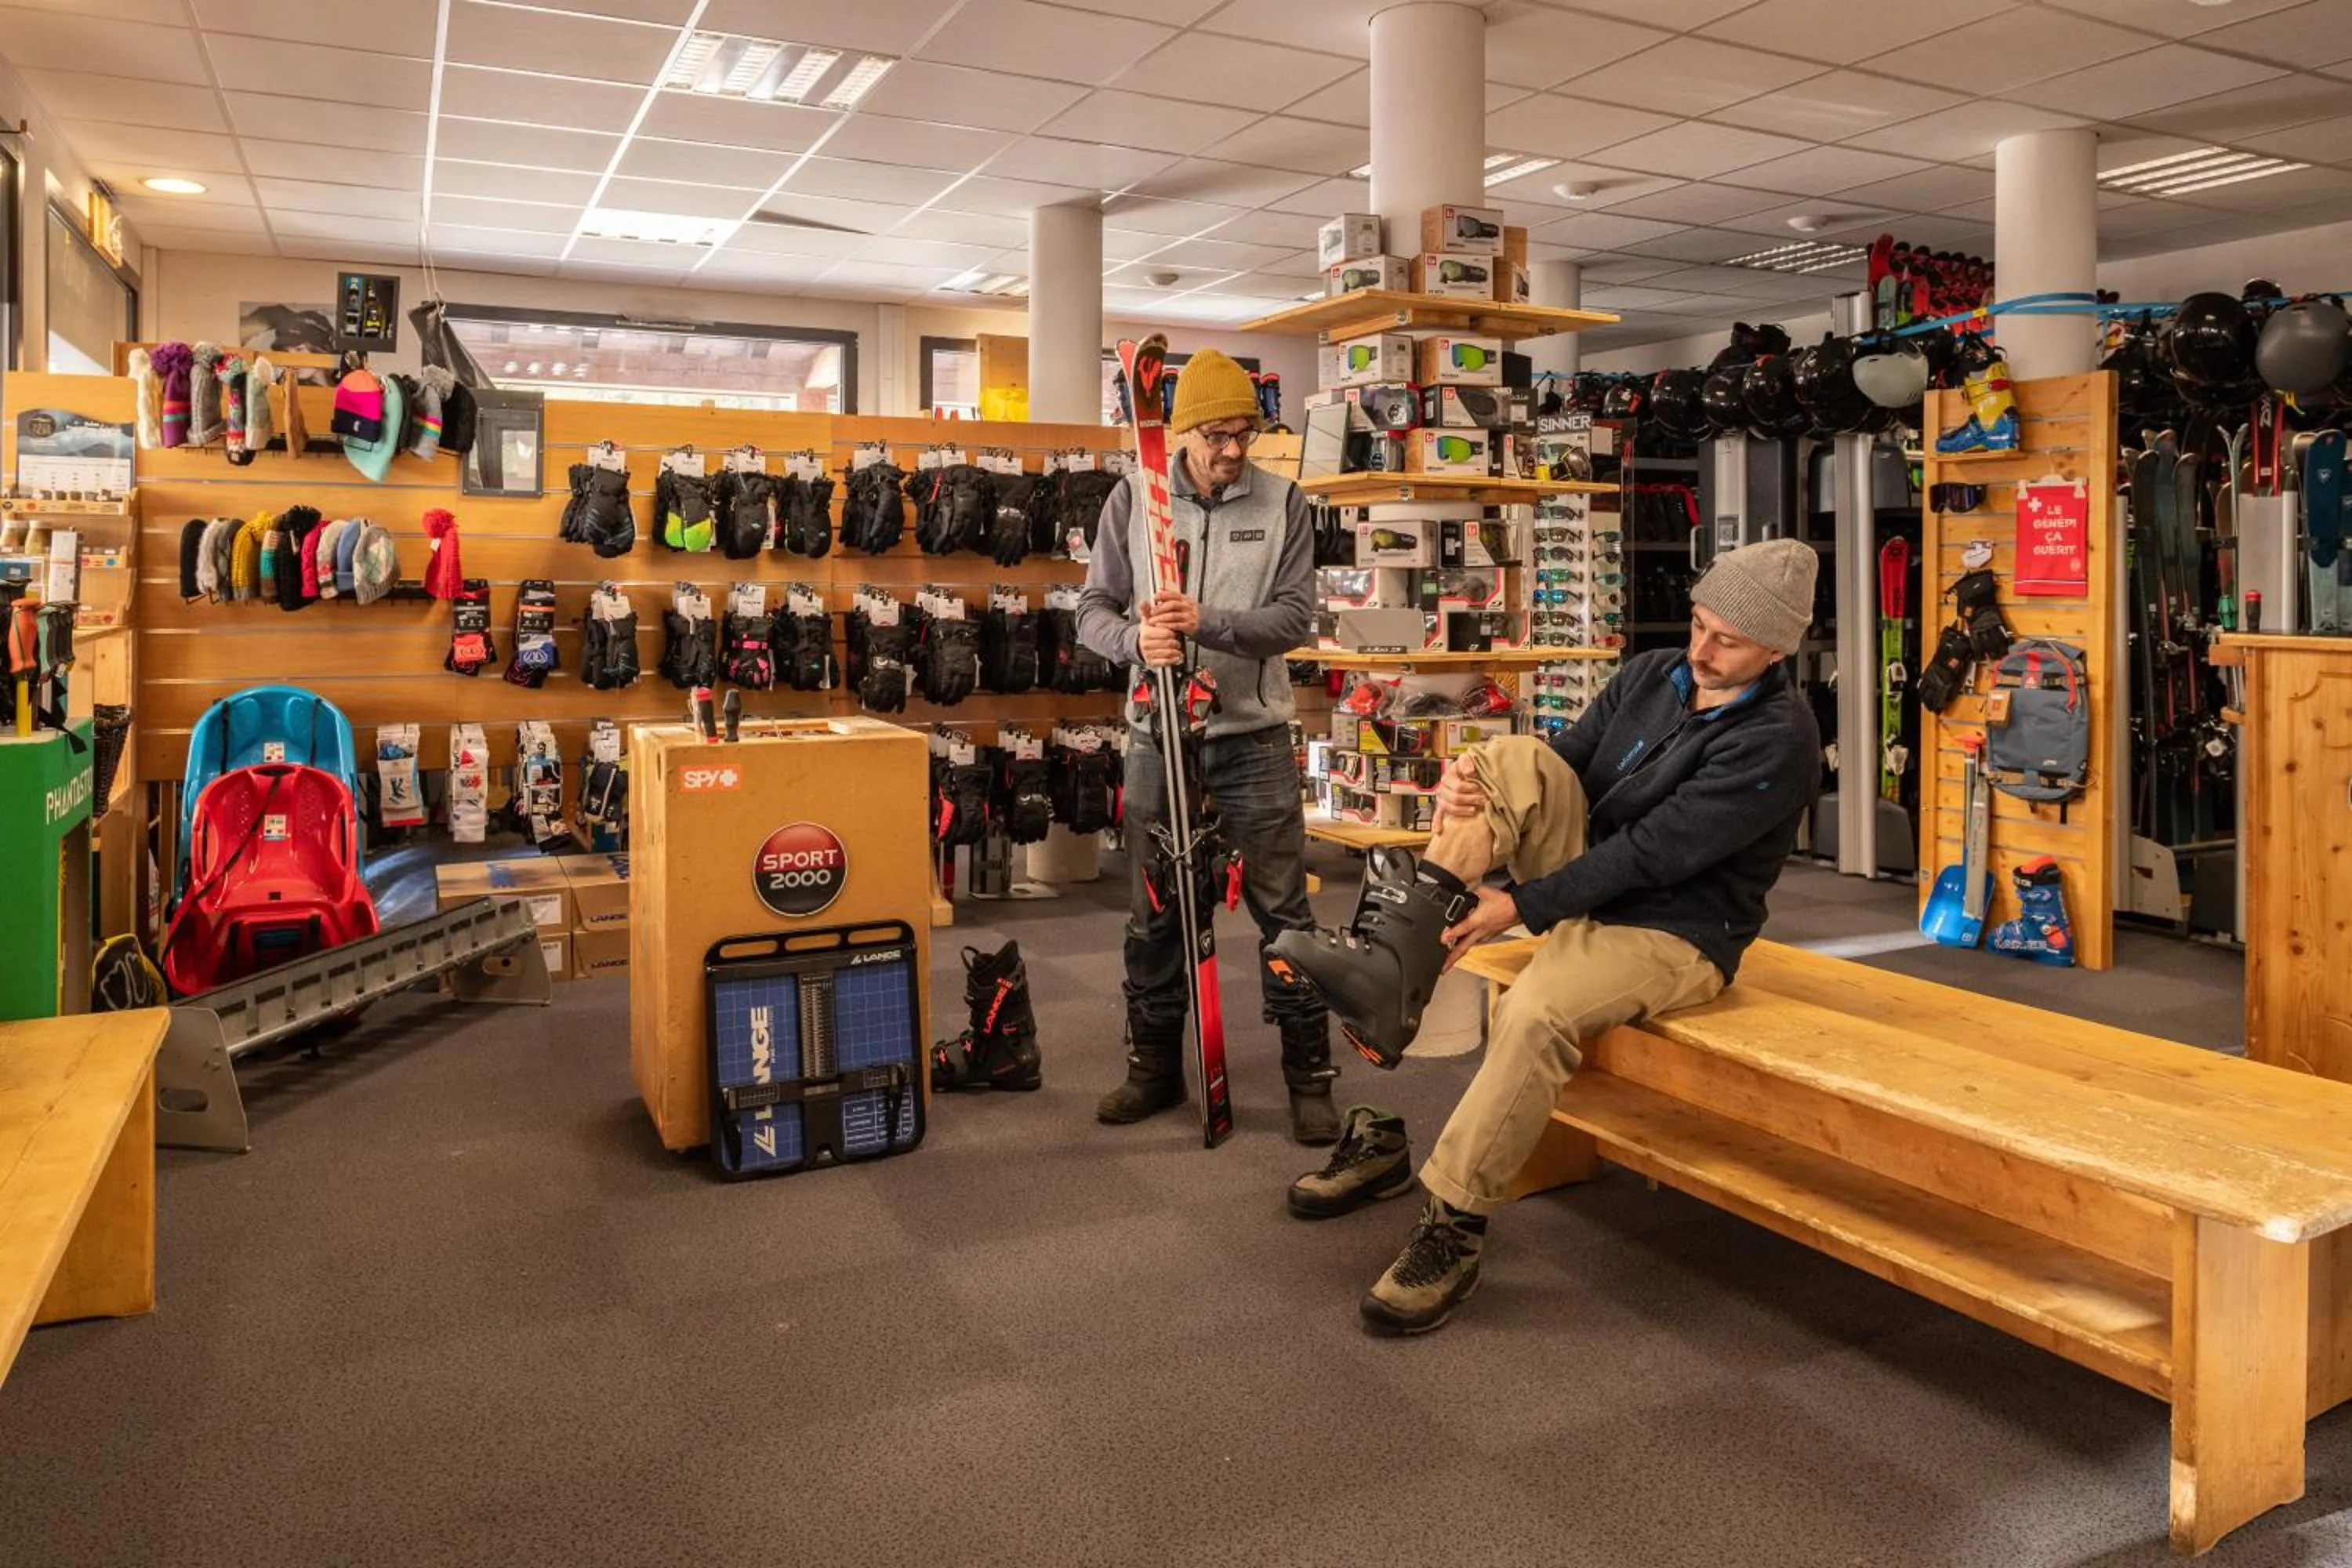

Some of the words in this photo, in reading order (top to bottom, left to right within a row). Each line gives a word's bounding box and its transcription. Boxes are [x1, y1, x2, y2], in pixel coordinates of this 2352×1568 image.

[1539, 415, 1591, 432] SINNER
[2047, 505, 2063, 515] LE
[2045, 531, 2063, 544] ÇA
[684, 769, 720, 789] SPY
[764, 849, 838, 871] SPORT
[770, 869, 832, 890] 2000
[750, 1005, 773, 1120] LNGE
